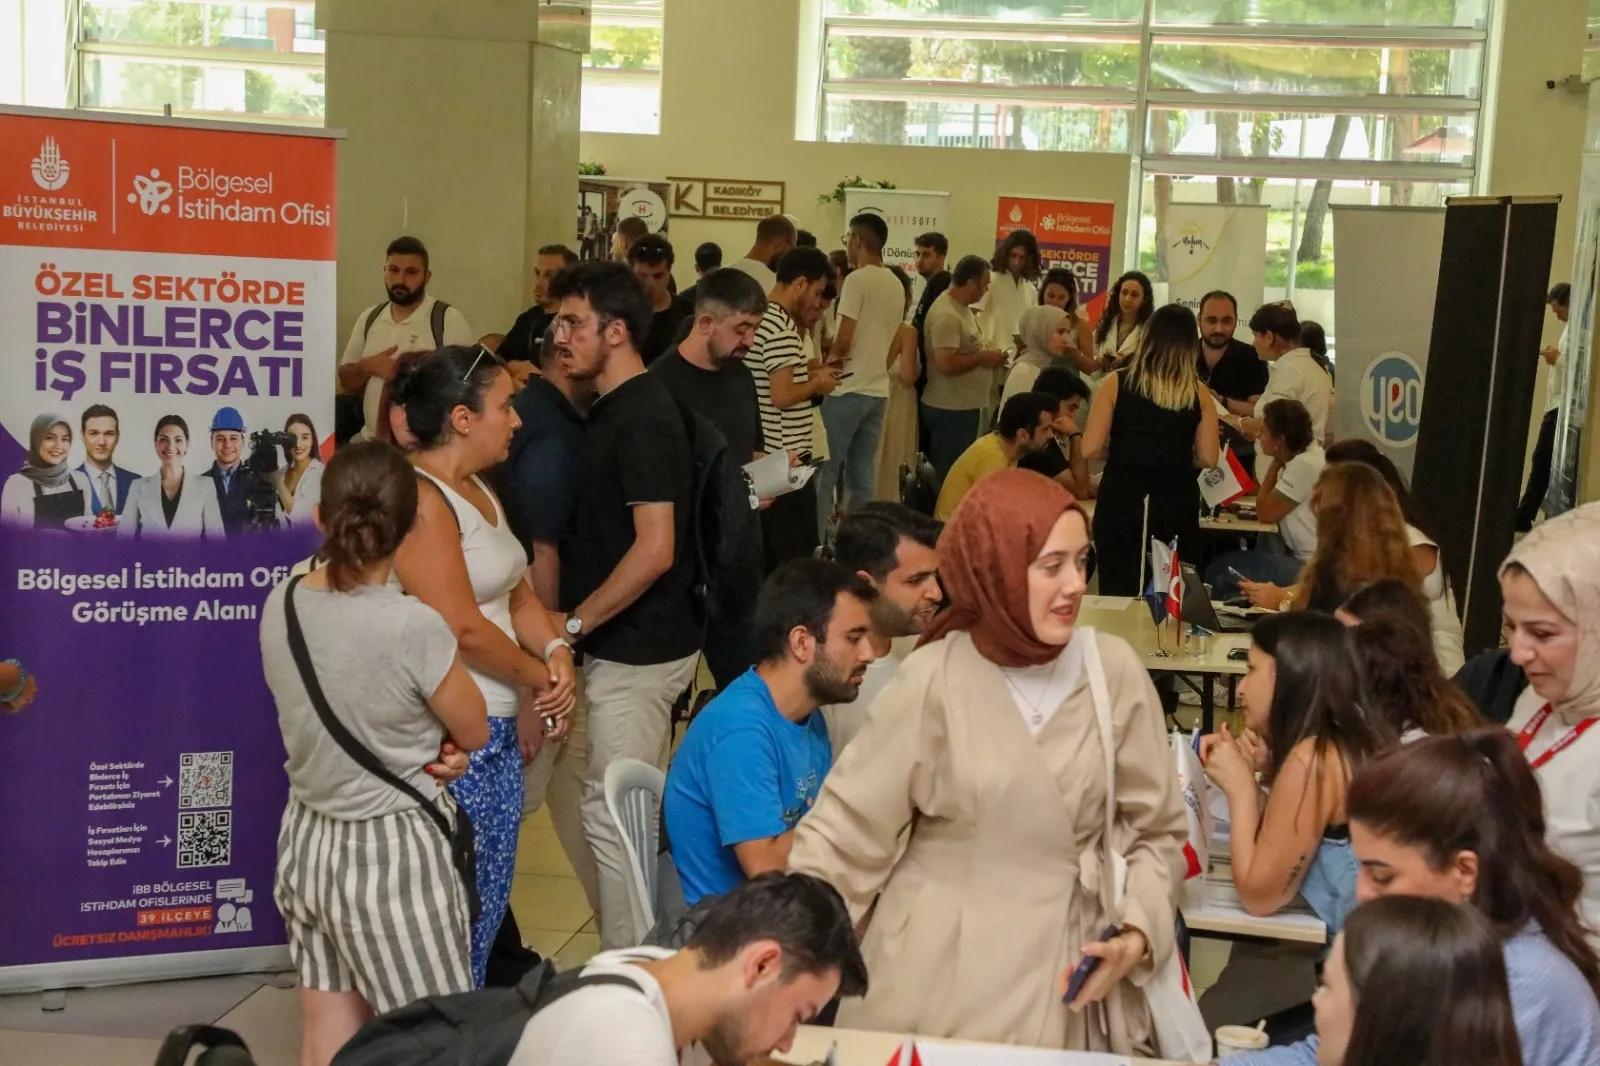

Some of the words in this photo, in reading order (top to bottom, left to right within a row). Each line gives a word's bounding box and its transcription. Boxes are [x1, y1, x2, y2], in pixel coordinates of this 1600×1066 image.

[178, 165, 273, 198] Bölgesel
[713, 184, 762, 197] KADIKÖY
[17, 194, 83, 206] İSTANBUL
[3, 203, 98, 222] BÜYÜKŞEHİR
[178, 188, 275, 224] İstihdam
[280, 202, 331, 227] Ofisi
[712, 204, 774, 216] BELEDİYESİ
[17, 221, 84, 232] BELEDİYESİ
[1040, 248, 1100, 261] SEKTÖRDE
[35, 262, 124, 299] ÖZEL
[132, 271, 305, 306] SEKTÖRDE
[100, 351, 303, 397] FIRSATI
[18, 567, 128, 595] Bölgesel
[134, 562, 244, 589] İstihdam
[72, 601, 188, 626] Görüşme
[193, 600, 256, 621] Alanı
[89, 762, 108, 771] Özel
[132, 791, 161, 800] Ziyaret
[88, 837, 115, 846] Sosyal
[87, 858, 108, 868] Takip
[109, 857, 127, 866] Edin
[153, 880, 213, 893] BÖLGESEL
[140, 913, 156, 924] 39
